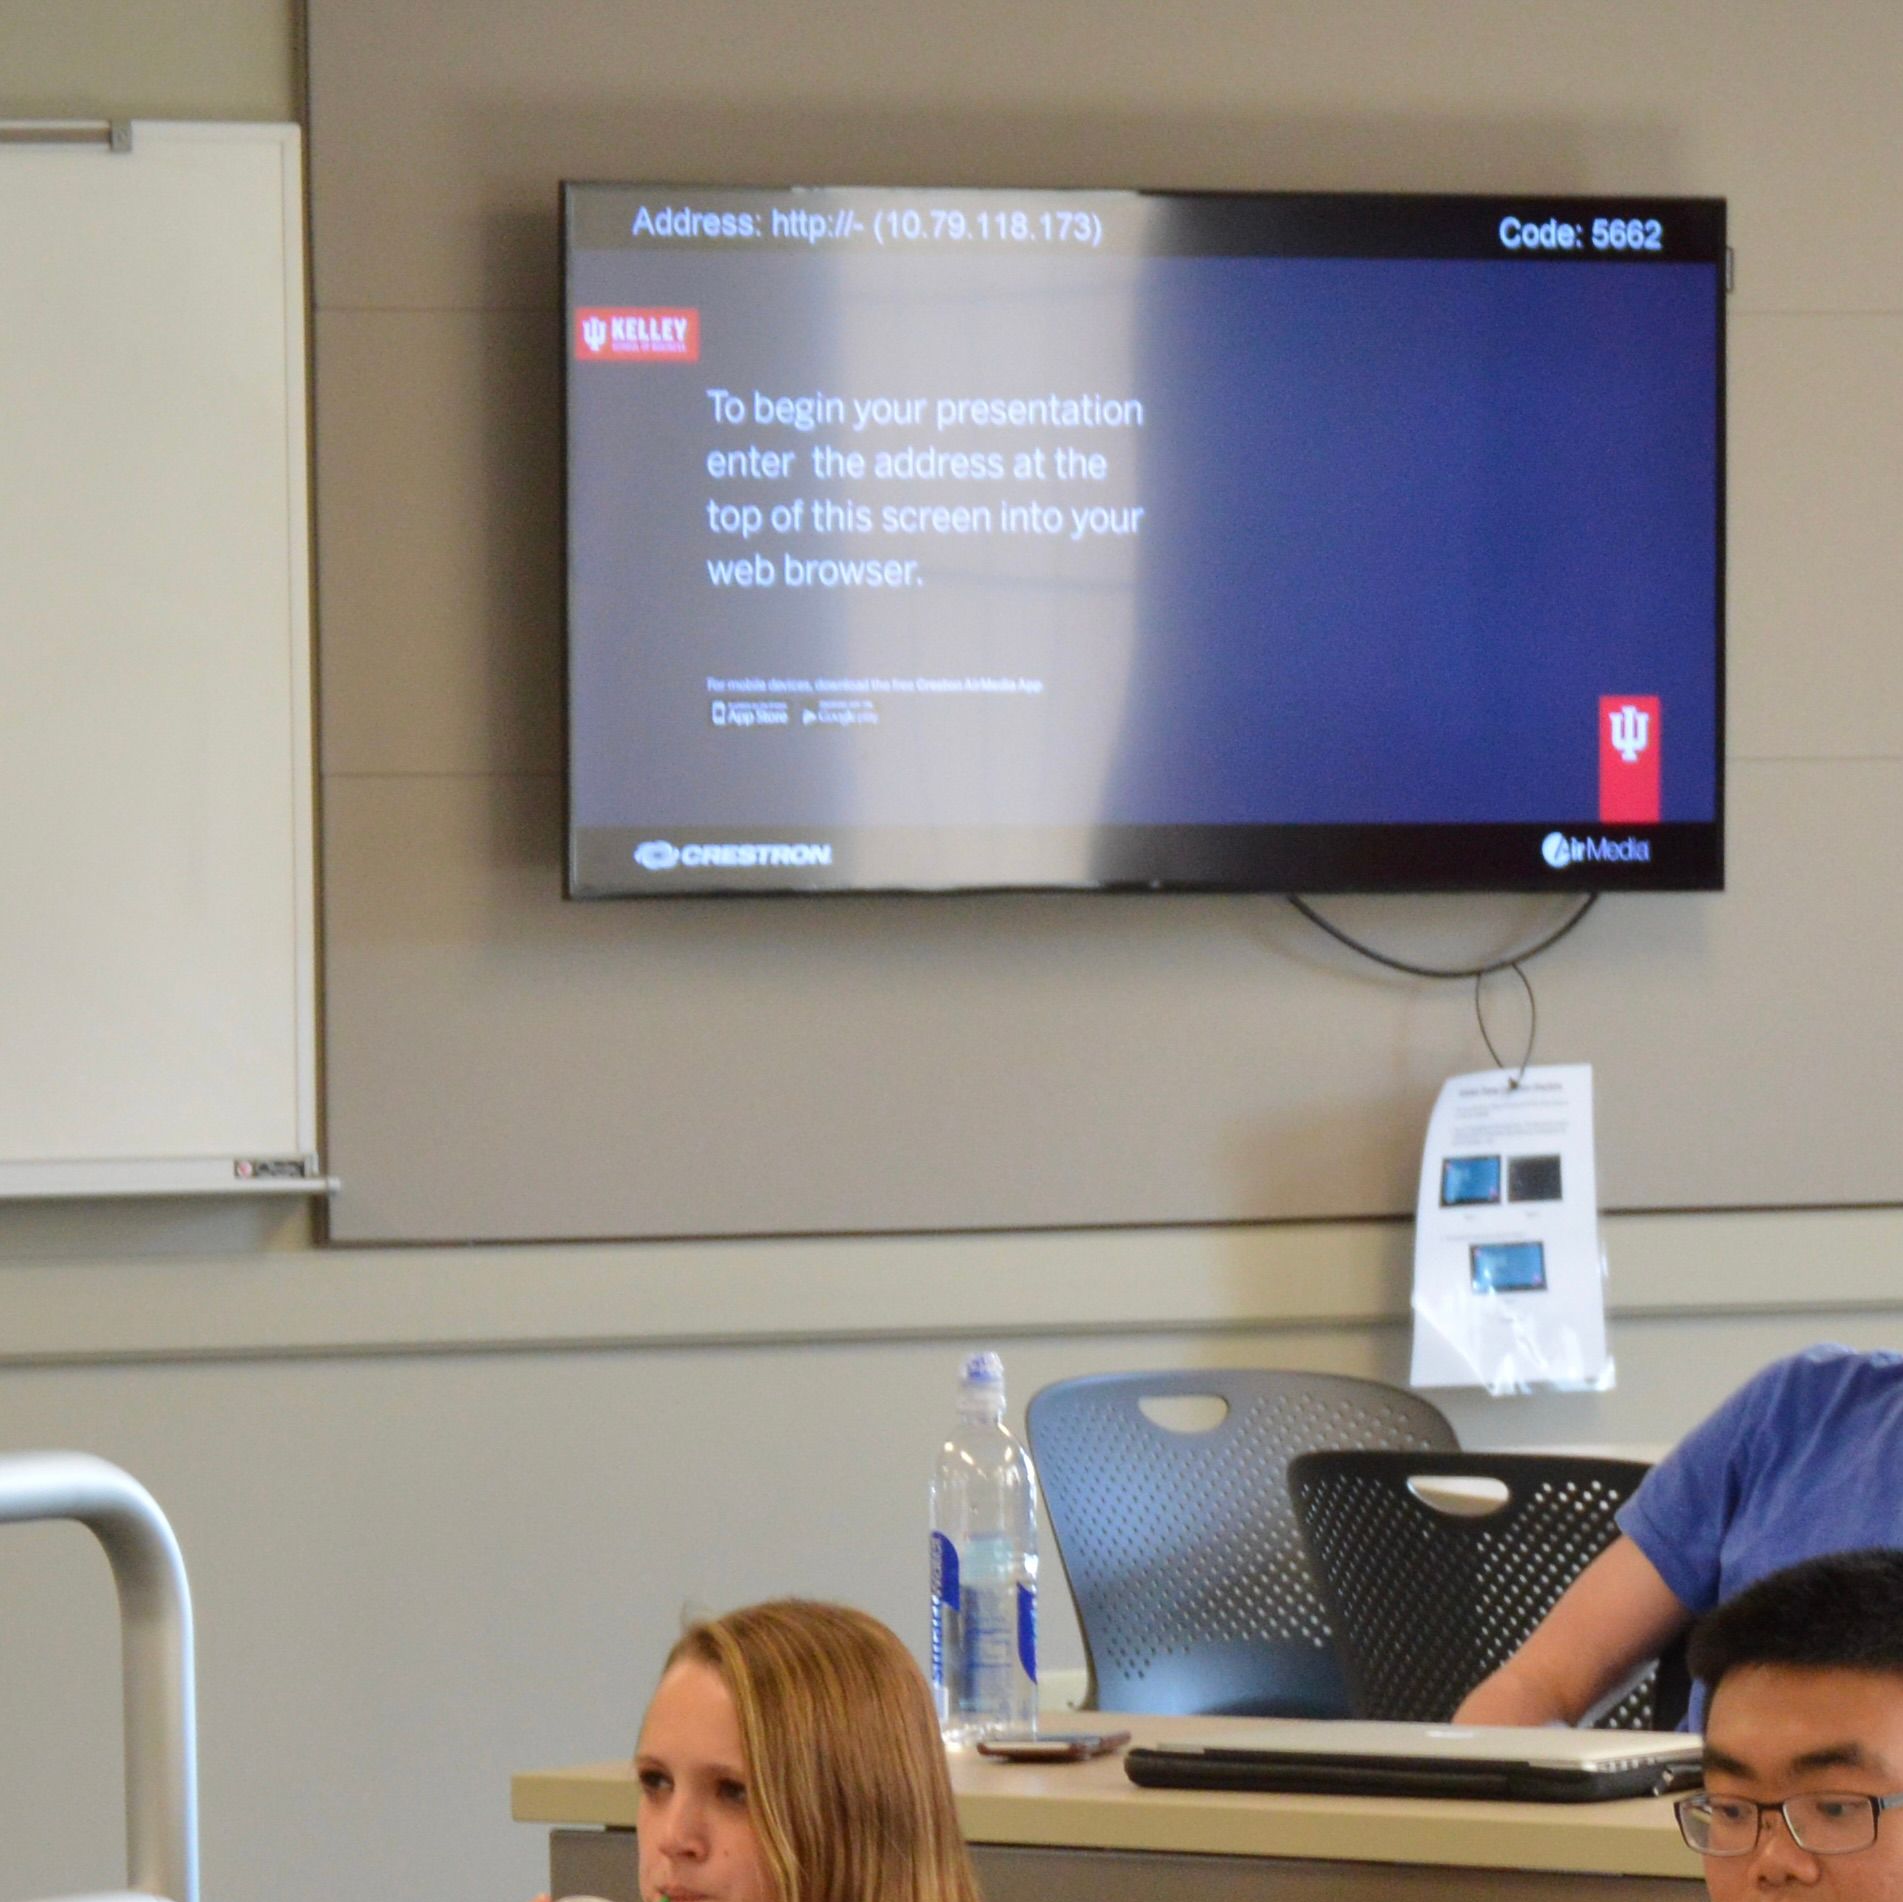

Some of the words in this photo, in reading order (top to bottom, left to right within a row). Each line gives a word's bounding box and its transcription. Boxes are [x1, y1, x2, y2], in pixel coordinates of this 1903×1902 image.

[632, 206, 762, 238] Address:
[873, 209, 1103, 247] (10.79.118.173)
[1499, 217, 1582, 250] Code:
[1591, 218, 1663, 251] 5662
[611, 316, 688, 341] KELLEY
[707, 389, 745, 424] To
[754, 390, 844, 431] begin
[852, 397, 927, 433] your
[936, 395, 1144, 432] presentation
[706, 448, 795, 480] enter
[812, 446, 865, 479] the
[874, 446, 1005, 480] address
[1012, 450, 1047, 480] at
[1054, 447, 1108, 480] the
[706, 500, 762, 539] top
[771, 499, 804, 534] of
[811, 499, 872, 534] this
[881, 505, 991, 534] screen
[999, 501, 1063, 535] into
[1069, 505, 1145, 541] your
[706, 552, 775, 587] web
[784, 554, 924, 588] browser.
[681, 844, 832, 866] CRESTRON
